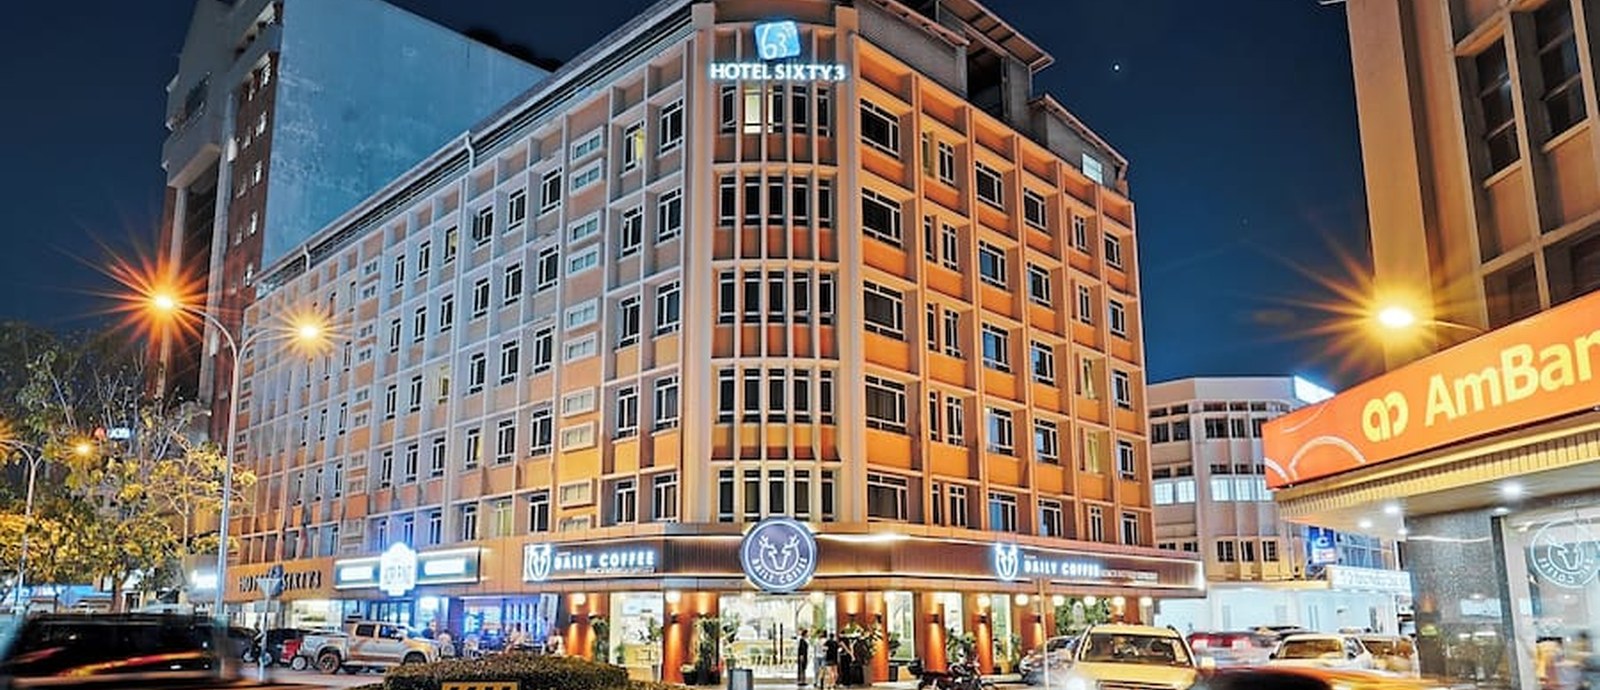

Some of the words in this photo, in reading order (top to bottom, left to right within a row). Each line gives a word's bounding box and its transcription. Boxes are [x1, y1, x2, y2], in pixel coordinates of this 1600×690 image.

[710, 63, 772, 80] HOTEL
[775, 63, 846, 81] SIXTY3
[554, 554, 594, 570] DAILY
[599, 551, 655, 567] COFFEE
[1023, 560, 1058, 575] DAILY
[1061, 562, 1100, 578] COFFEE
[751, 557, 774, 582] DAILY
[778, 556, 808, 584] COFFEE
